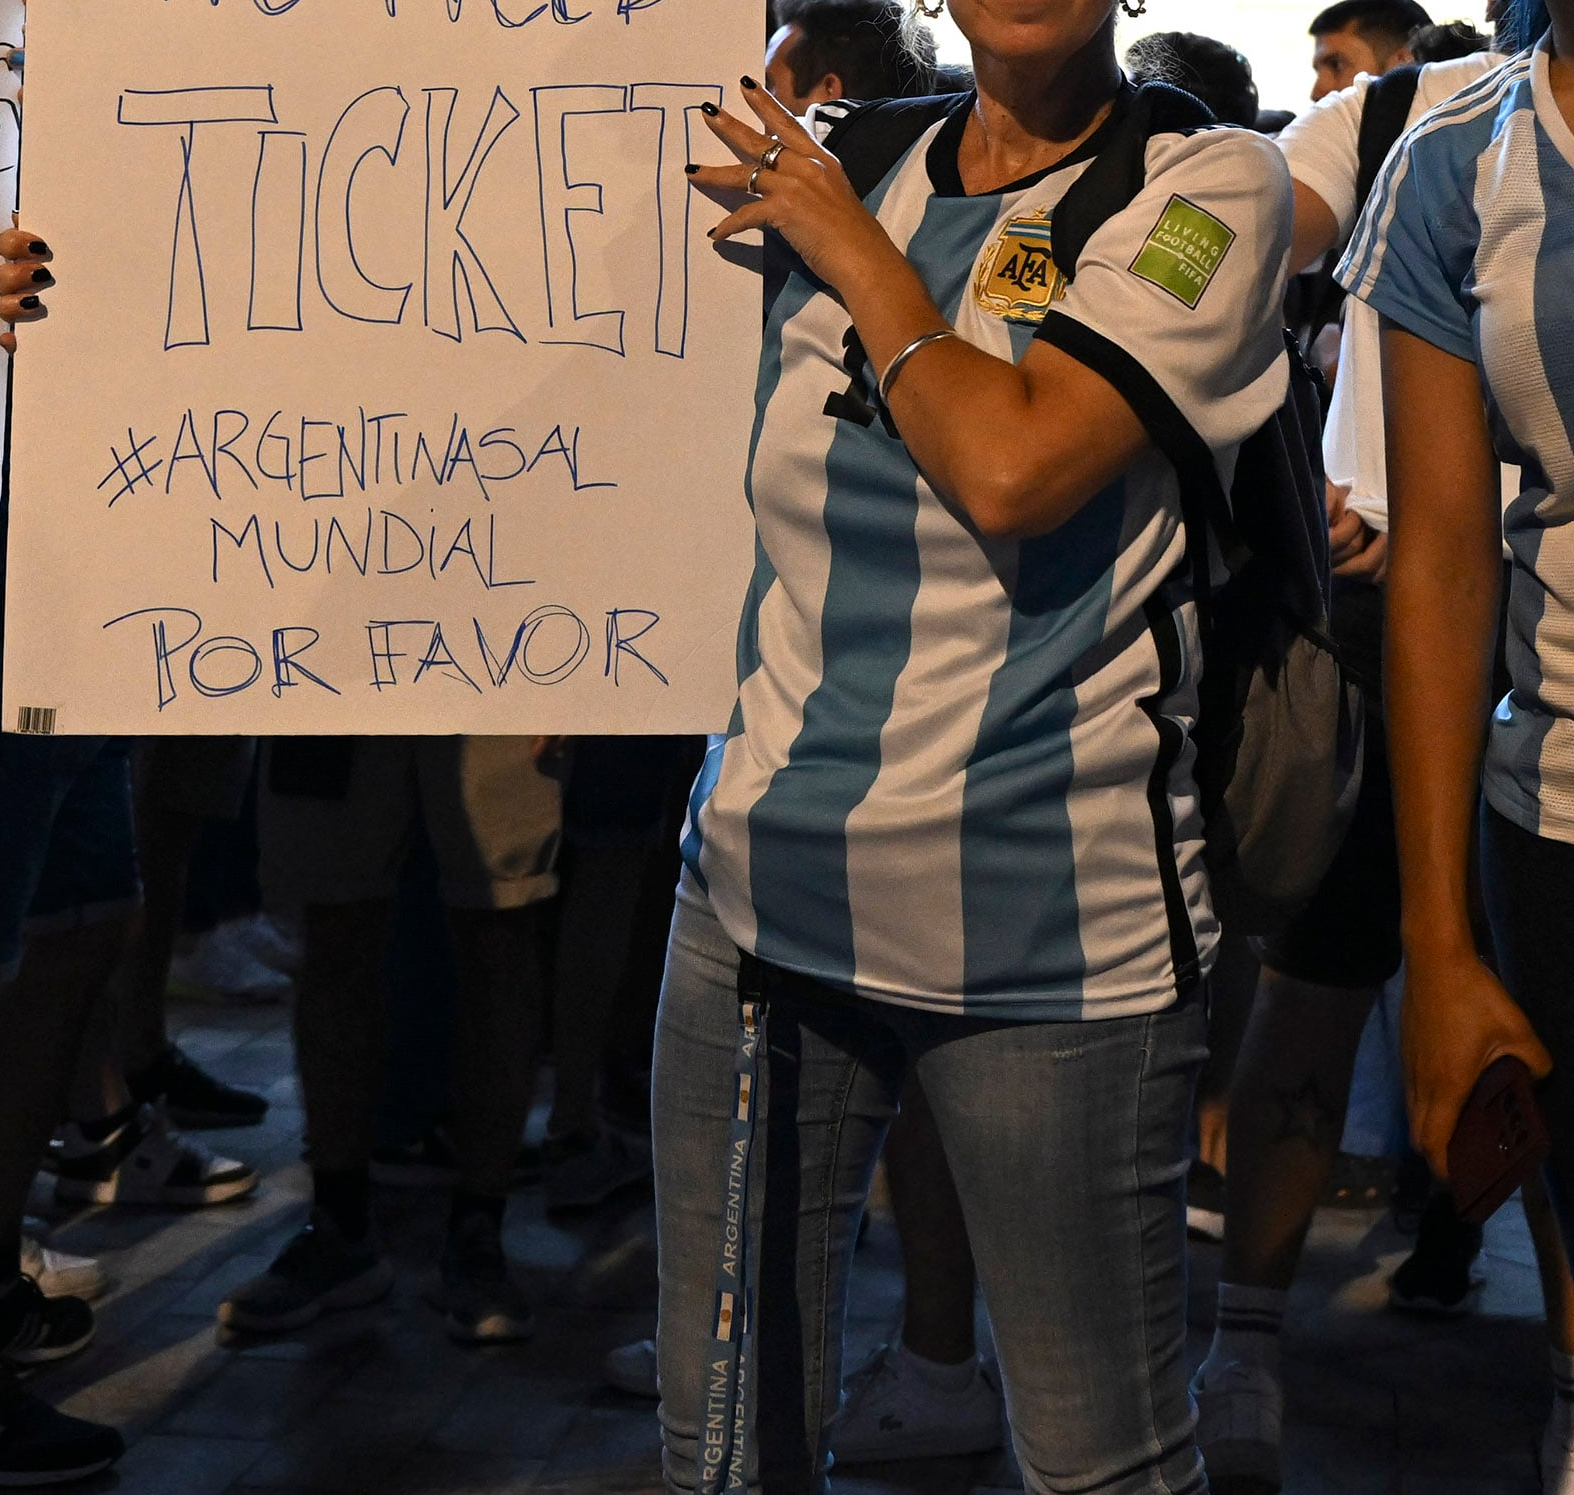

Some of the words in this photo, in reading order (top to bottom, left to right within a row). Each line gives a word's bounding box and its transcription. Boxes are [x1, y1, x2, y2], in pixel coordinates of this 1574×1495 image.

[117, 84, 724, 359] TICKET
[1162, 219, 1219, 257] LIVING
[996, 242, 1053, 292] AFA
[1154, 230, 1212, 270] FOOTBALL
[1177, 262, 1203, 286] FIFA
[103, 606, 342, 712] POR
[365, 604, 670, 695] FAVOR
[722, 1138, 748, 1279] ARGENTINA
